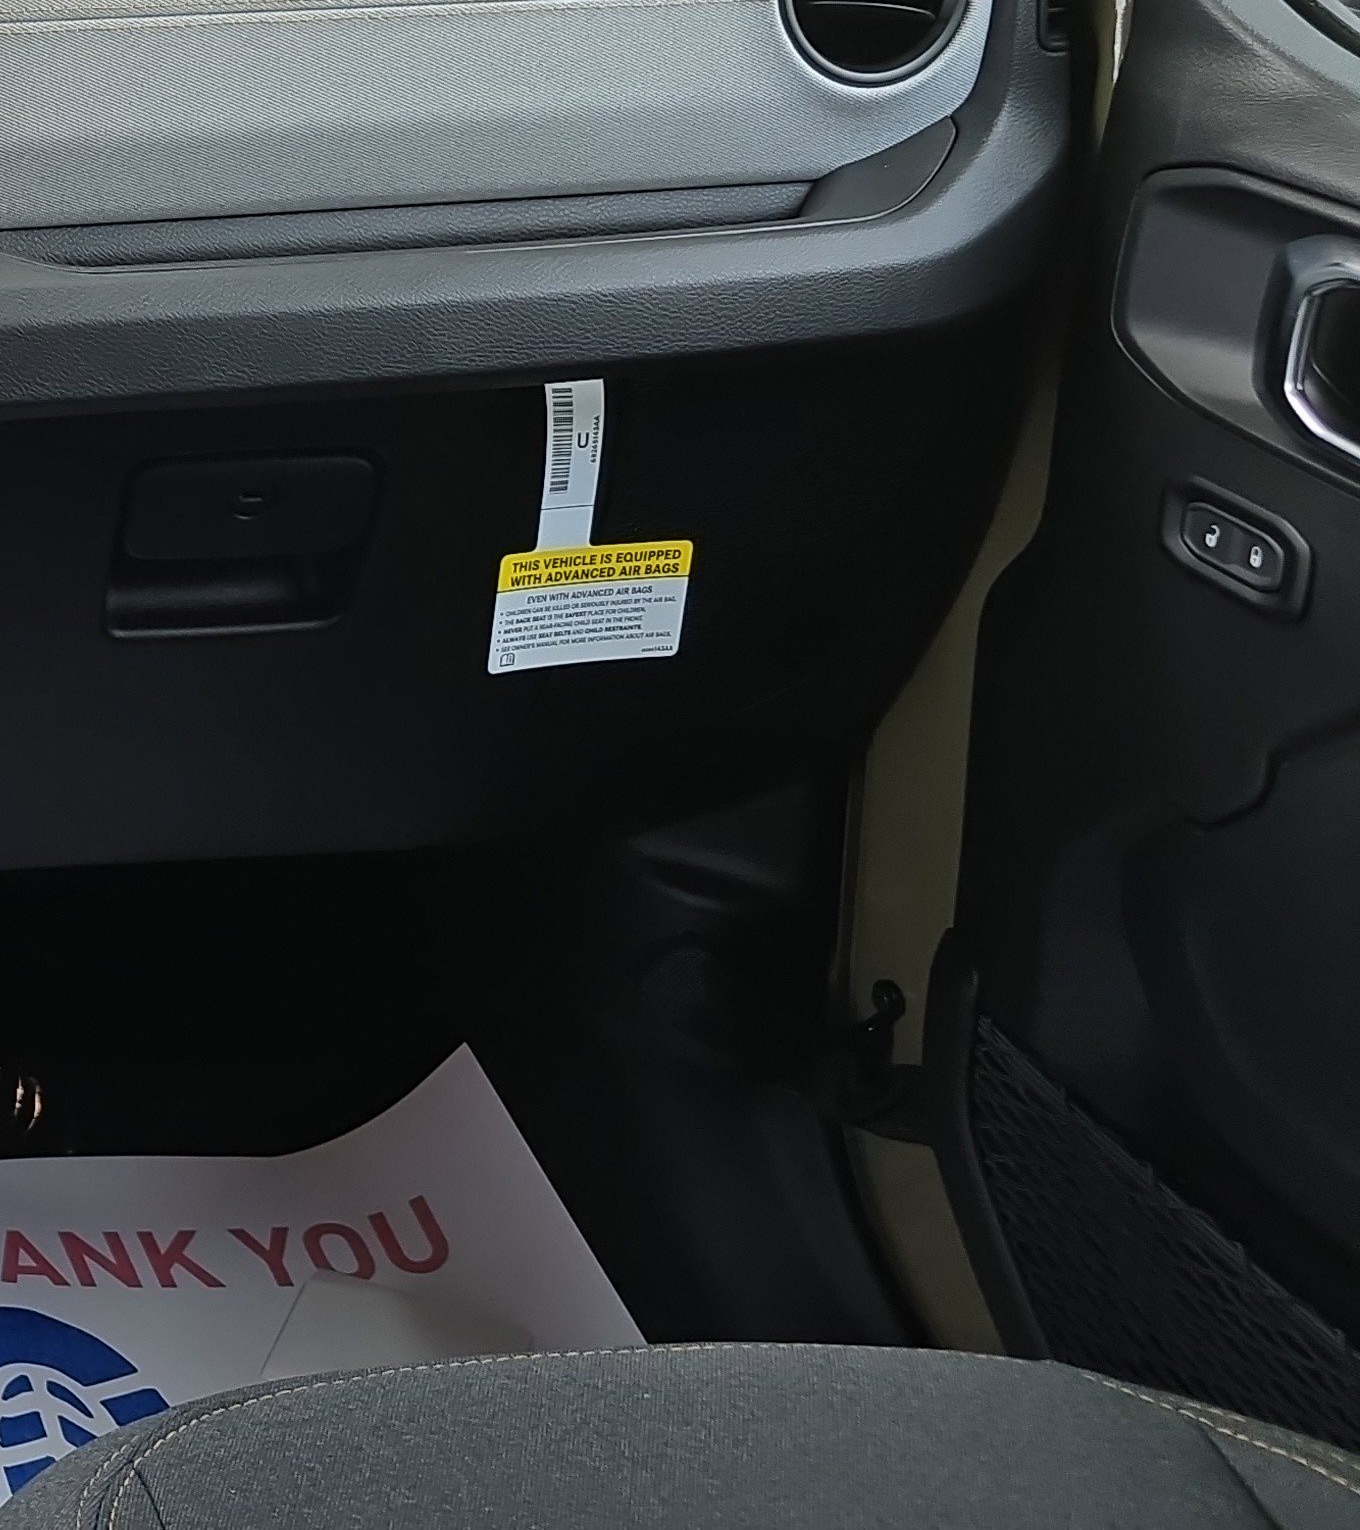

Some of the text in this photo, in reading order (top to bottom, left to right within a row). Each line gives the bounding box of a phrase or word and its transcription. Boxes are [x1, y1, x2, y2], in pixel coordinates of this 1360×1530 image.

[577, 432, 590, 448] U
[512, 549, 682, 573] THIS VEHICLE IS EQUIPPED
[510, 563, 679, 588] WITH ADVANCED AIR BAGS
[527, 595, 547, 604] EVEN
[549, 593, 569, 602] WITH
[571, 589, 614, 600] ADVANCED
[631, 586, 652, 595] BAGS
[228, 1194, 450, 1289] YOU
